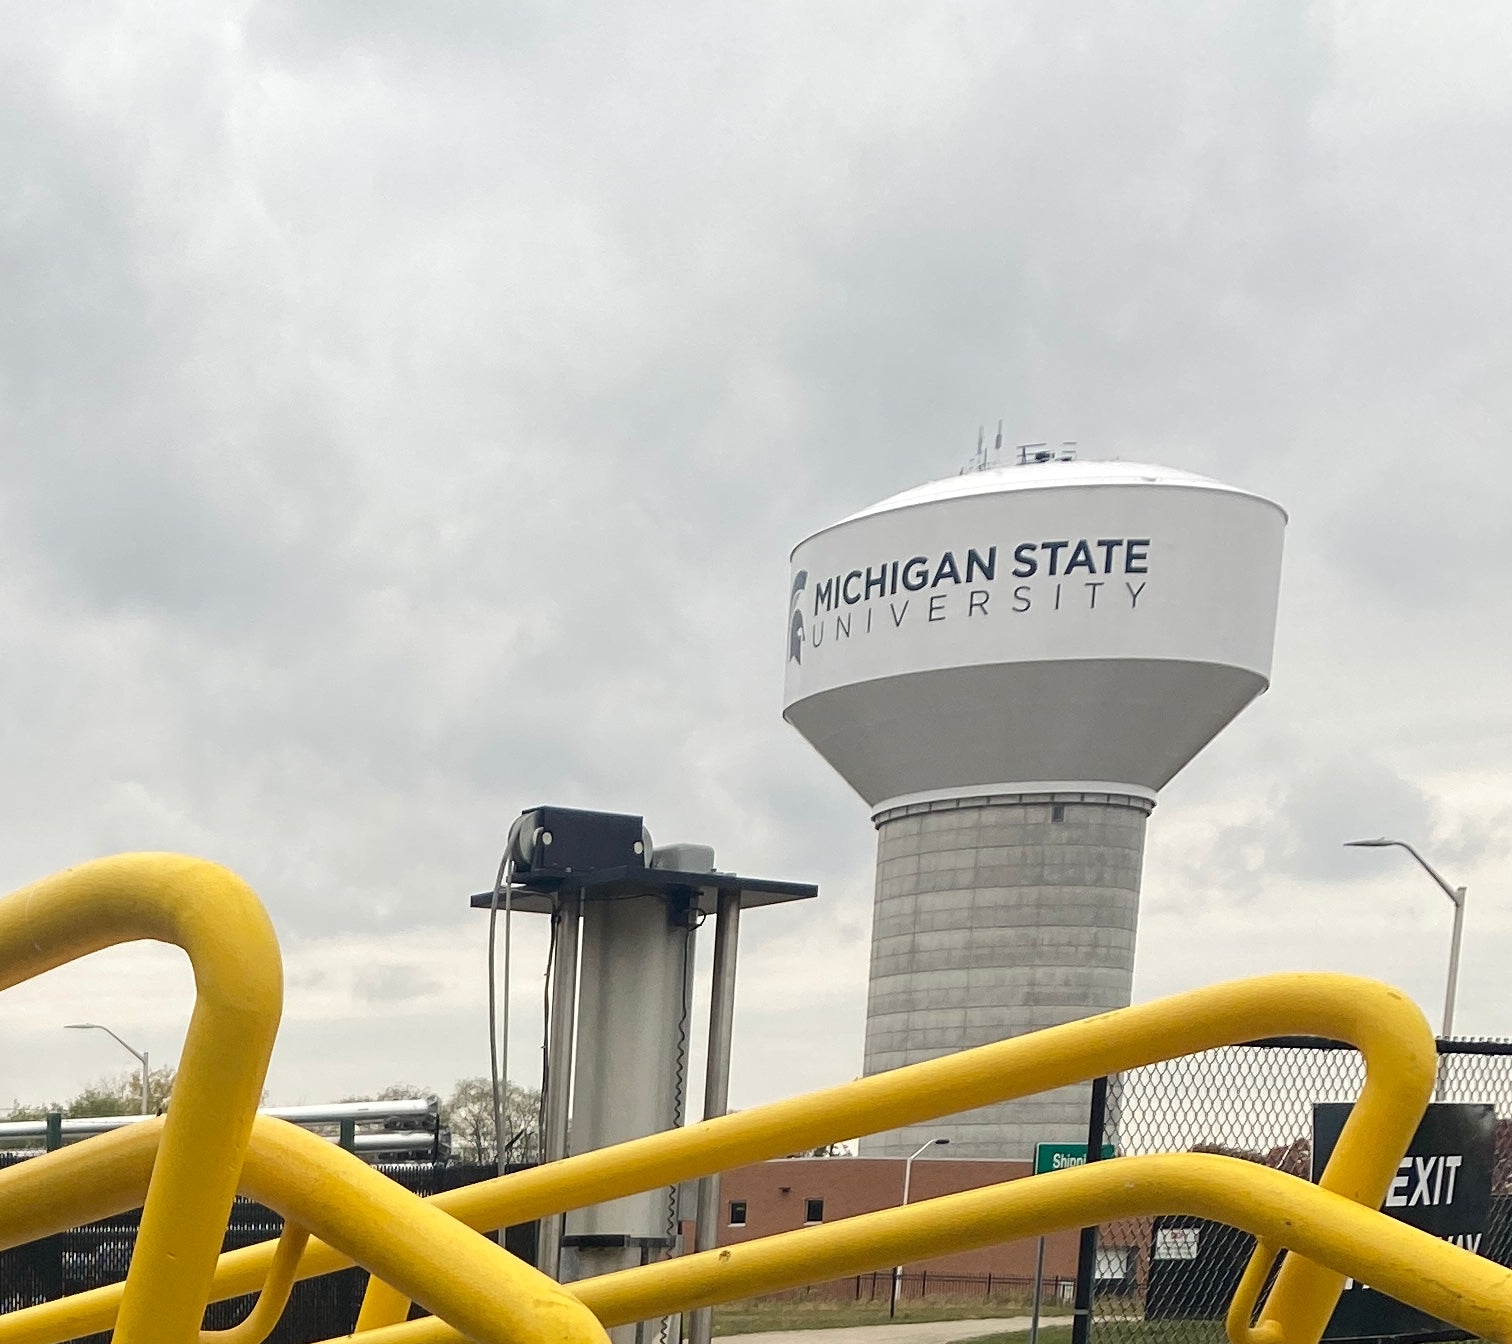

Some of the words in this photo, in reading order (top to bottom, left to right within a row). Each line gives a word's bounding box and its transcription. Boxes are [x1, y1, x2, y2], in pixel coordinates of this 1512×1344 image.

[814, 547, 996, 616] MICHIGAN
[1012, 538, 1151, 578] STATE
[812, 581, 1147, 649] UNIVERSITY
[1052, 1153, 1087, 1168] Shippi
[1385, 1155, 1462, 1207] EXIT
